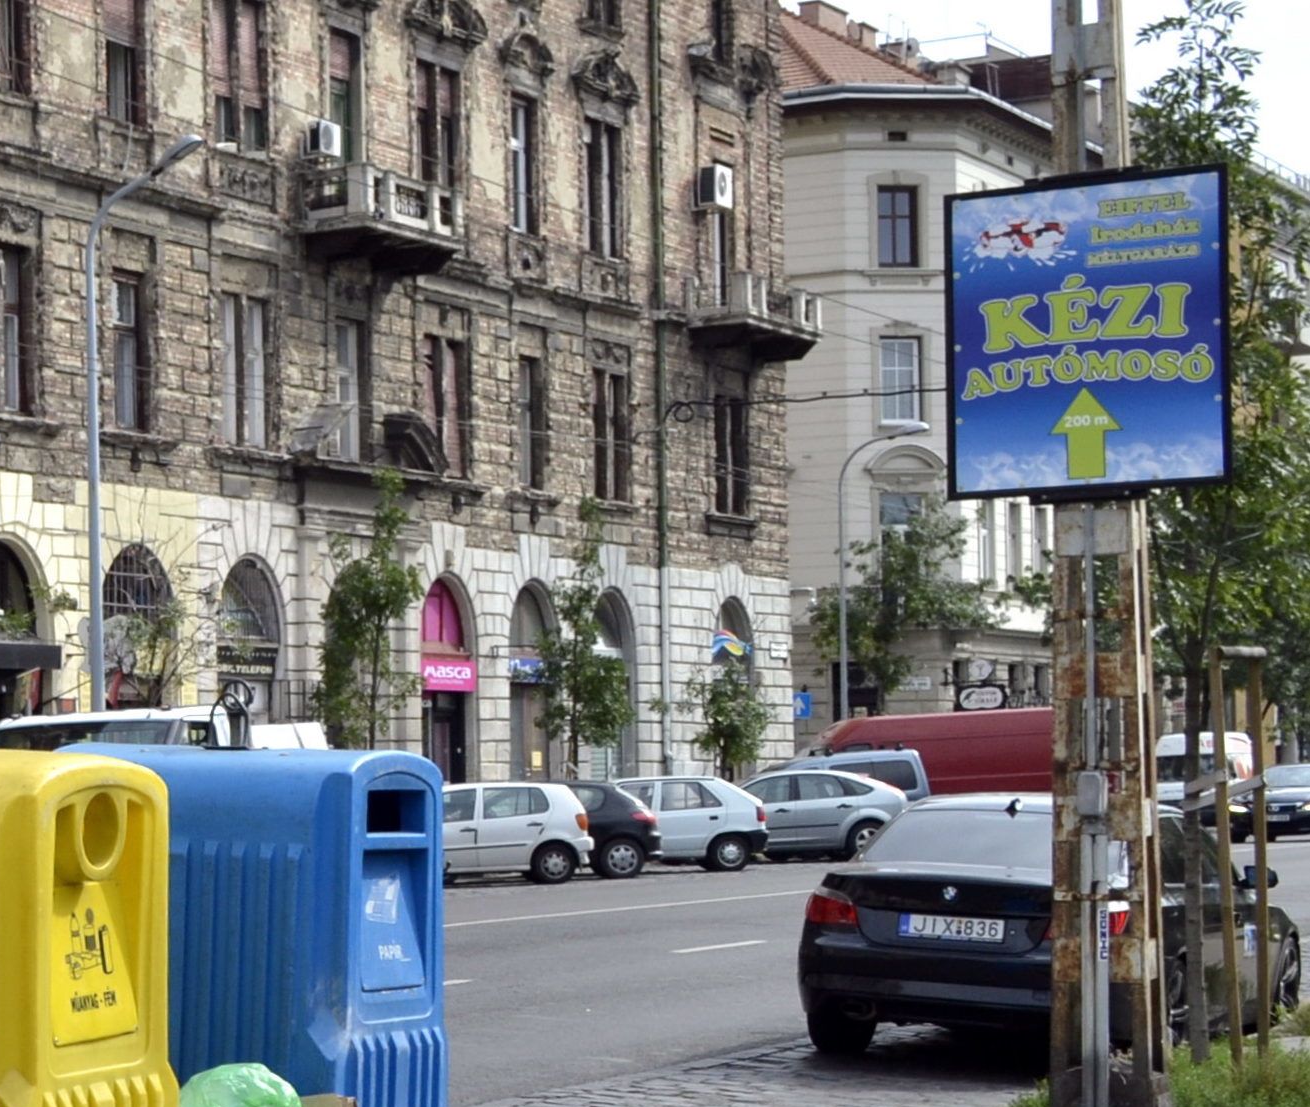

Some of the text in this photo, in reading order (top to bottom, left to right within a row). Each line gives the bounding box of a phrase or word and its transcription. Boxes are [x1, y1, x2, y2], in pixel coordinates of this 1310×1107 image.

[1098, 192, 1190, 218] EIFFEL
[981, 275, 1191, 353] KÉZI
[961, 345, 1214, 400] AUTÓMOSÓ
[1064, 415, 1109, 428] 200 m
